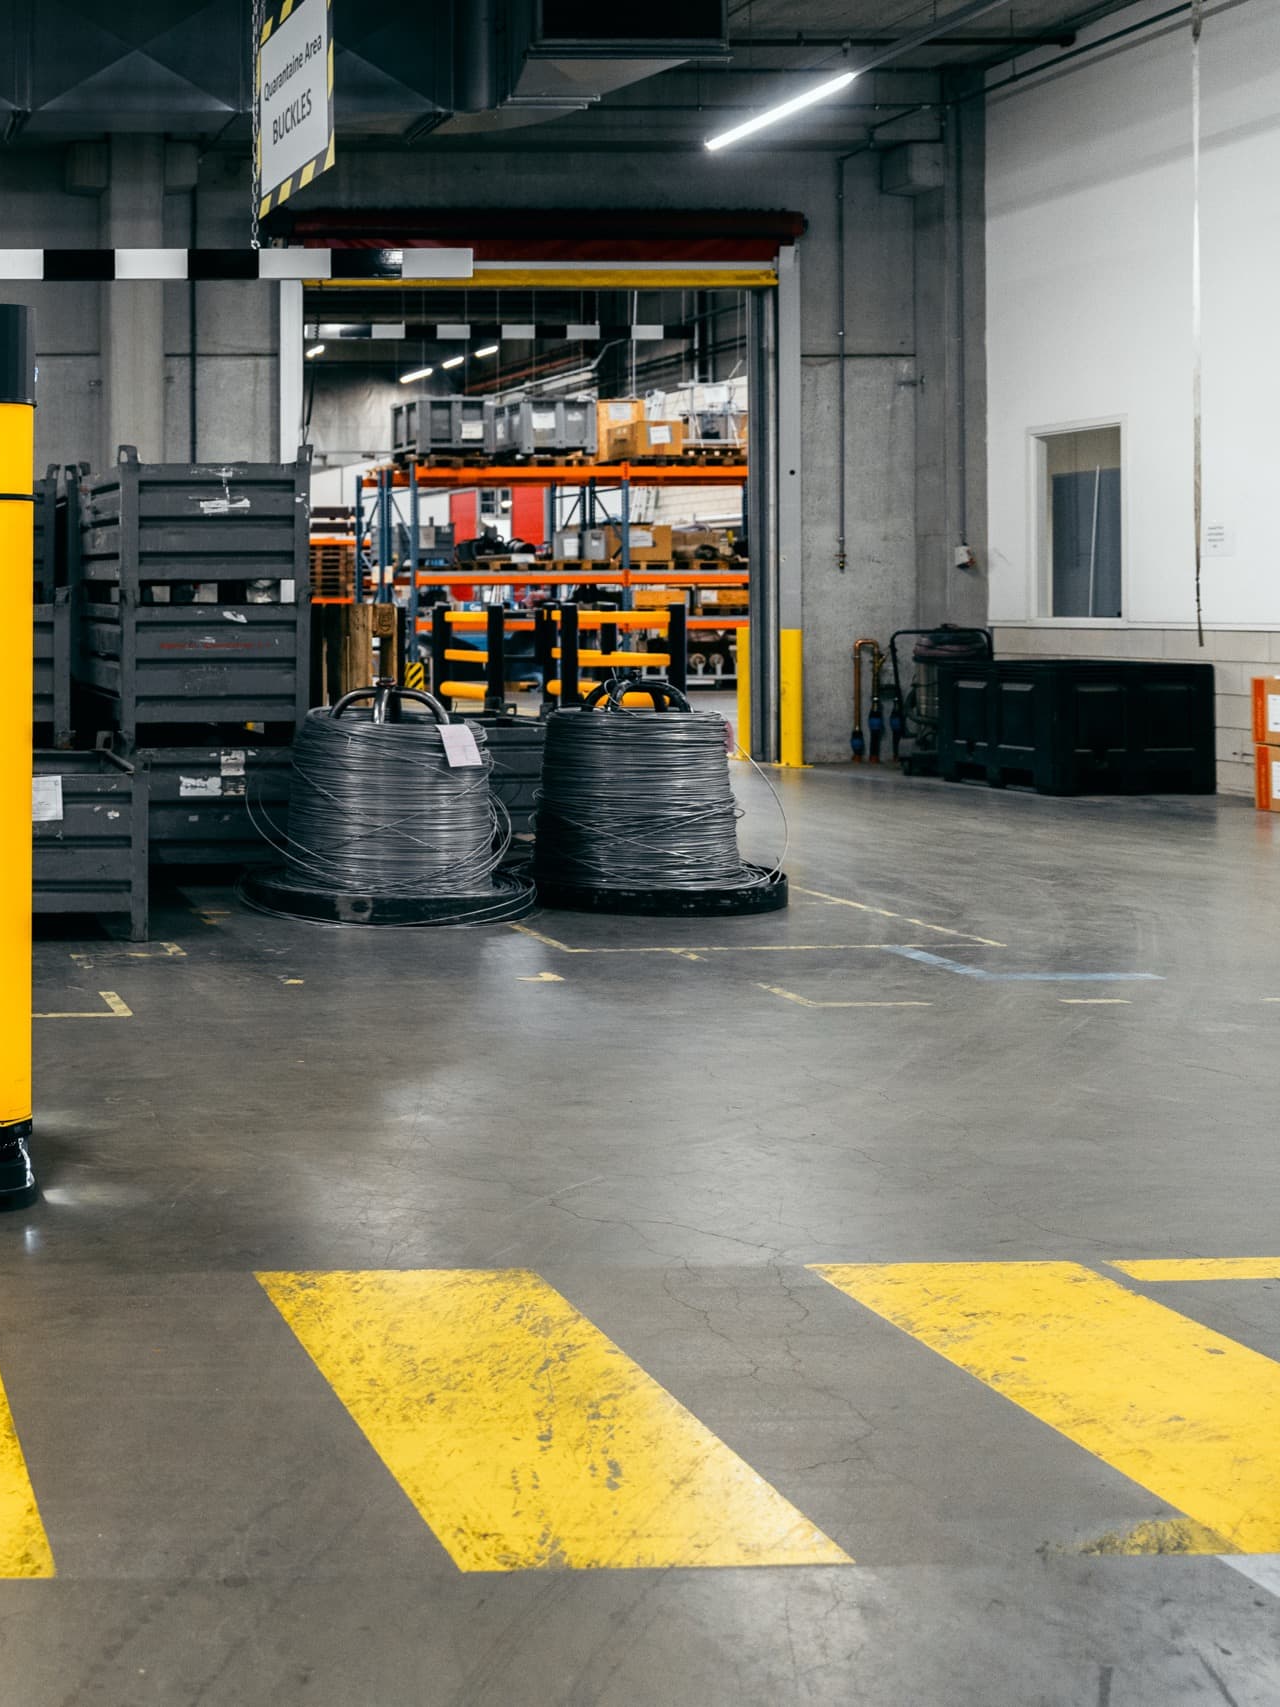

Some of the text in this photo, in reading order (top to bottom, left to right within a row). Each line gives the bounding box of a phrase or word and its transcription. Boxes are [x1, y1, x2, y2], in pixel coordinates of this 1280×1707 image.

[263, 35, 322, 102] Quarantaine Area
[272, 88, 312, 145] BUCKLES
